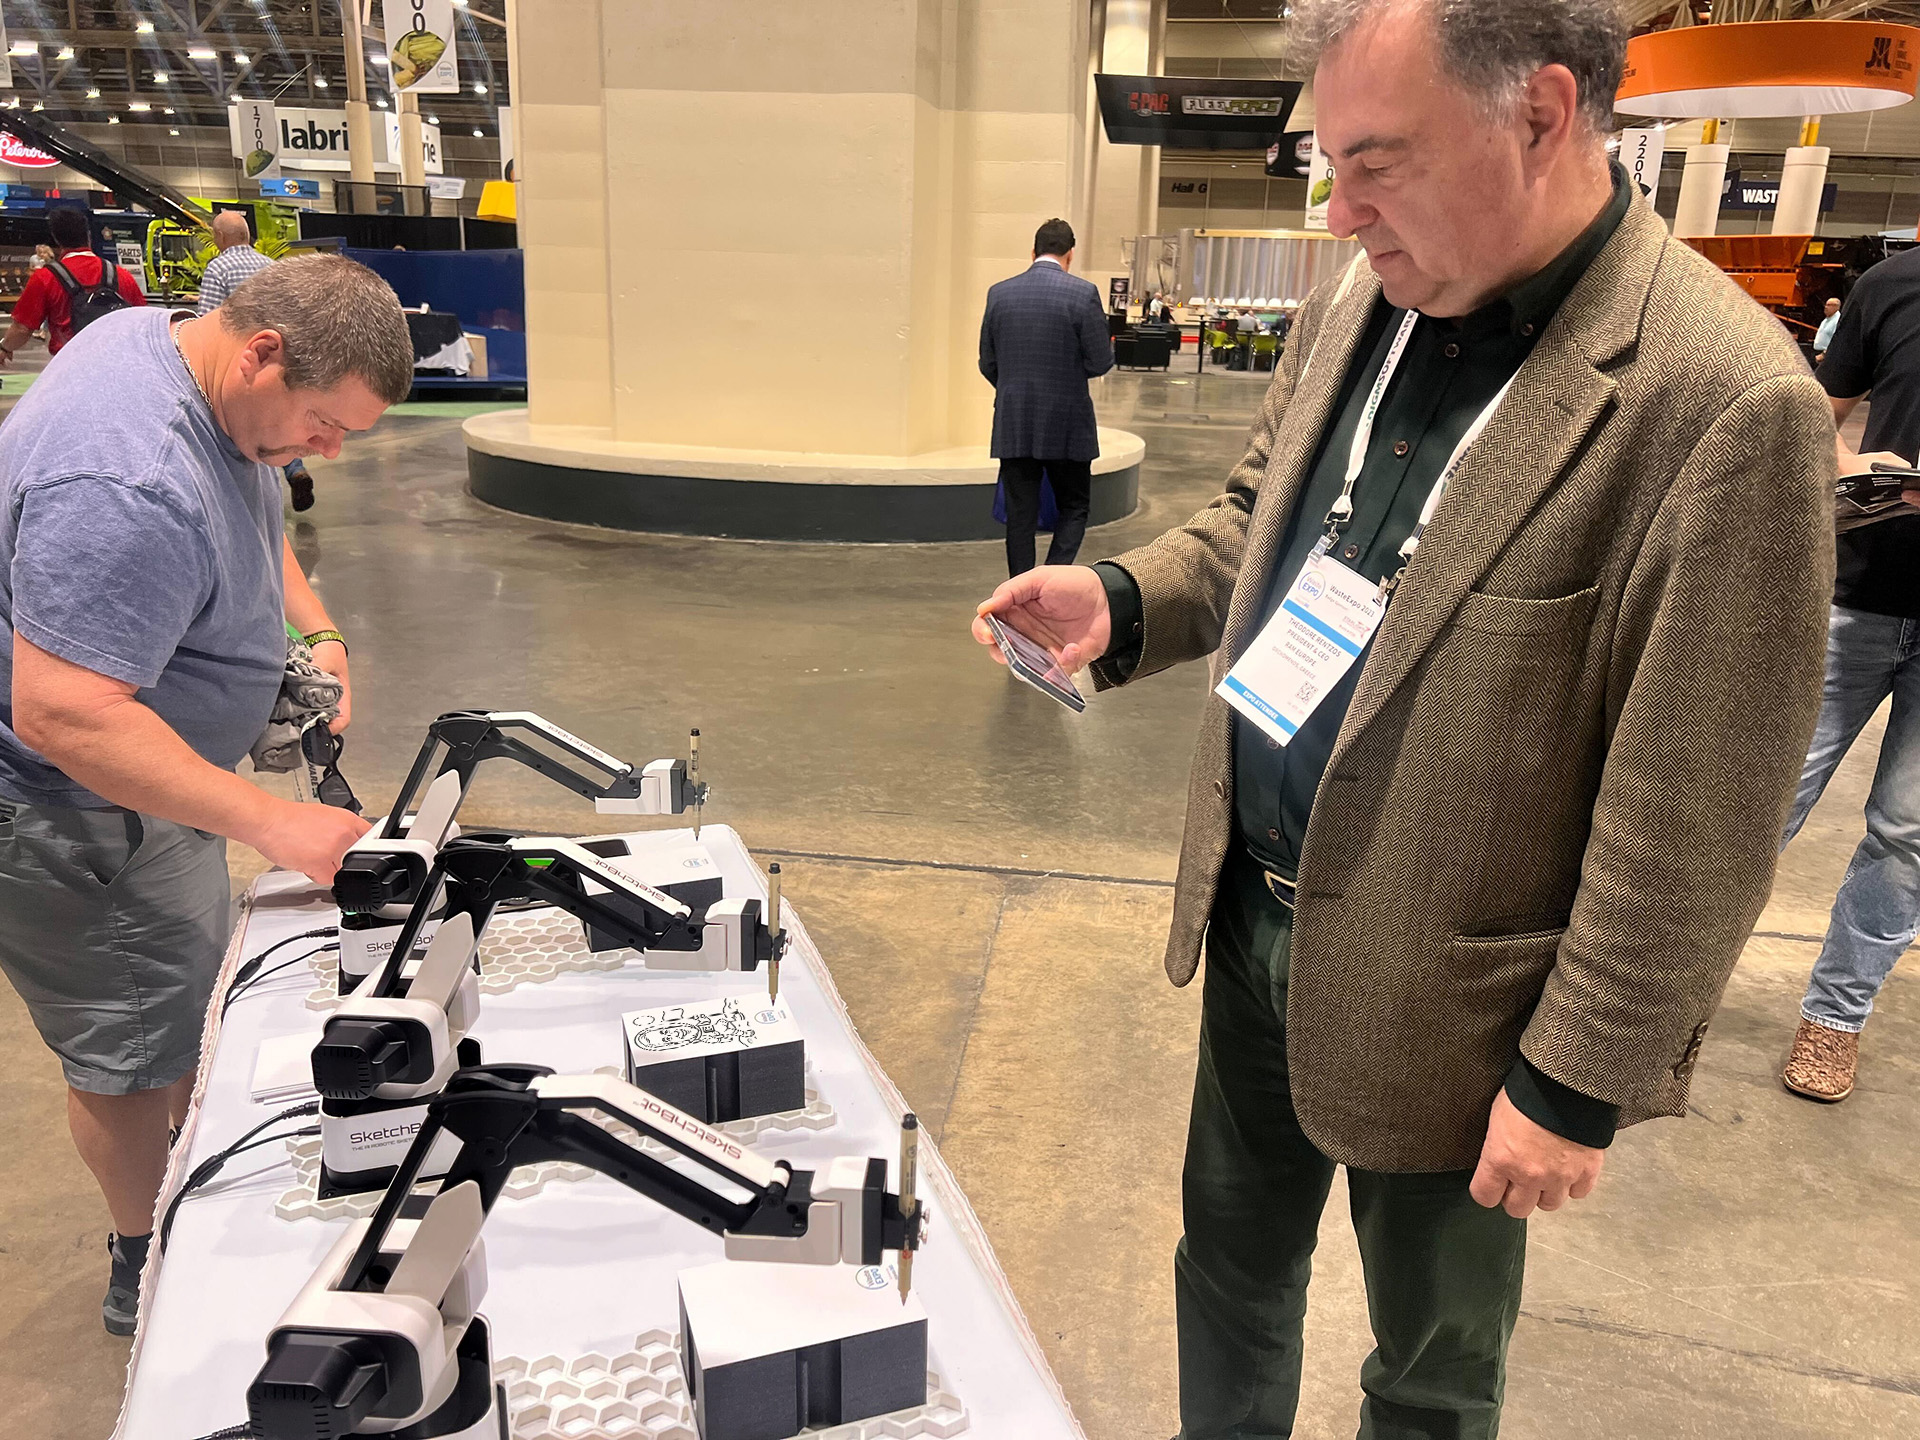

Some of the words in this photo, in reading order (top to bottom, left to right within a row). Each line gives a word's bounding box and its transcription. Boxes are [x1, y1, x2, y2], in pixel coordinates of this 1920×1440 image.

[253, 105, 264, 151] 1700
[0, 138, 56, 160] Peter
[1171, 182, 1194, 193] Hall
[1198, 183, 1208, 194] G
[118, 248, 142, 257] PARTS
[1301, 582, 1319, 597] EXPO
[1329, 584, 1362, 609] WasteExpo
[1288, 617, 1317, 640] THEODORE
[1286, 628, 1314, 650] PRESIDENT
[1317, 650, 1330, 662] CEO
[1294, 648, 1317, 667] EUROPE
[594, 857, 667, 902] SketchBot
[640, 1098, 742, 1160] SketchBot
